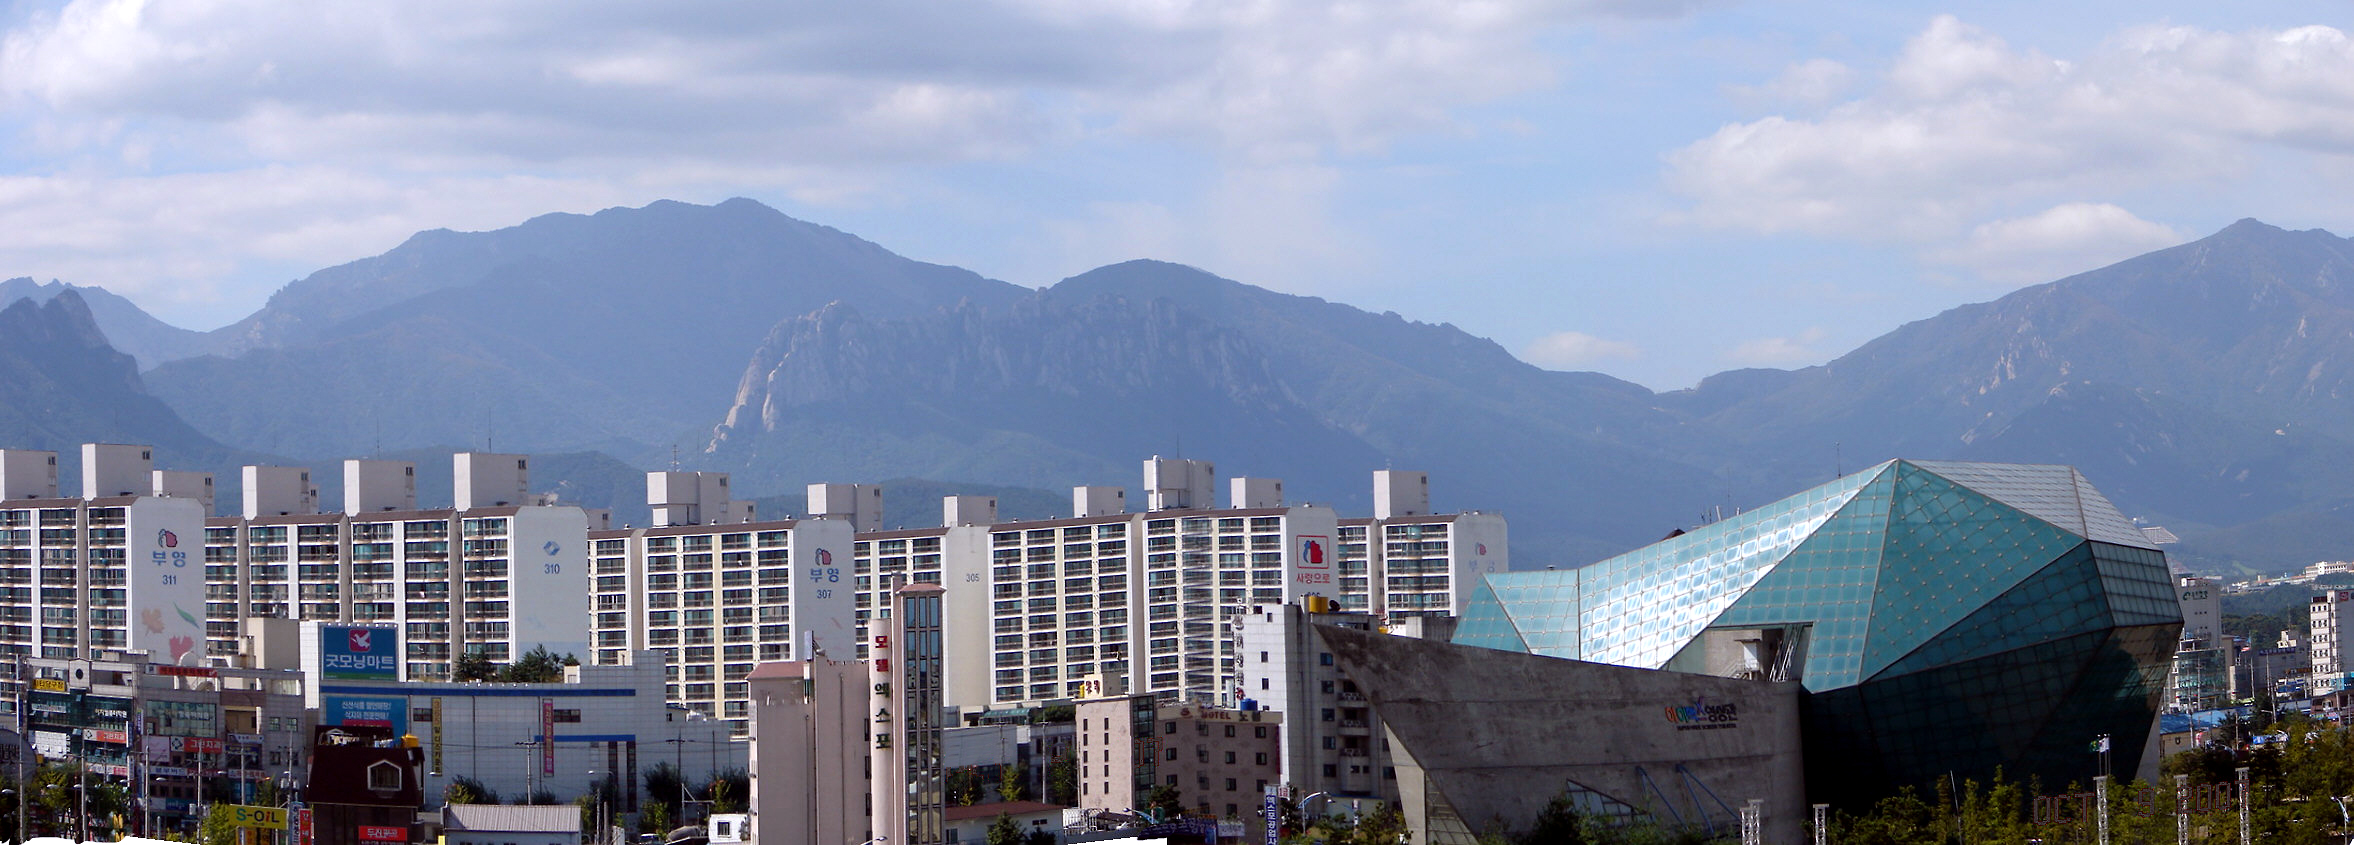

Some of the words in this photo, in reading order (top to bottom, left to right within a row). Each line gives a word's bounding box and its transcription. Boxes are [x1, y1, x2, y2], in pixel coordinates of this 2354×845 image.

[152, 550, 187, 568] 부영
[544, 563, 561, 574] 310
[162, 574, 177, 585] 311
[810, 568, 840, 583] 부영
[966, 573, 980, 582] 305
[1296, 573, 1330, 584] 사랑으로
[816, 589, 832, 599] 307
[326, 654, 394, 670] 굿모닝마트
